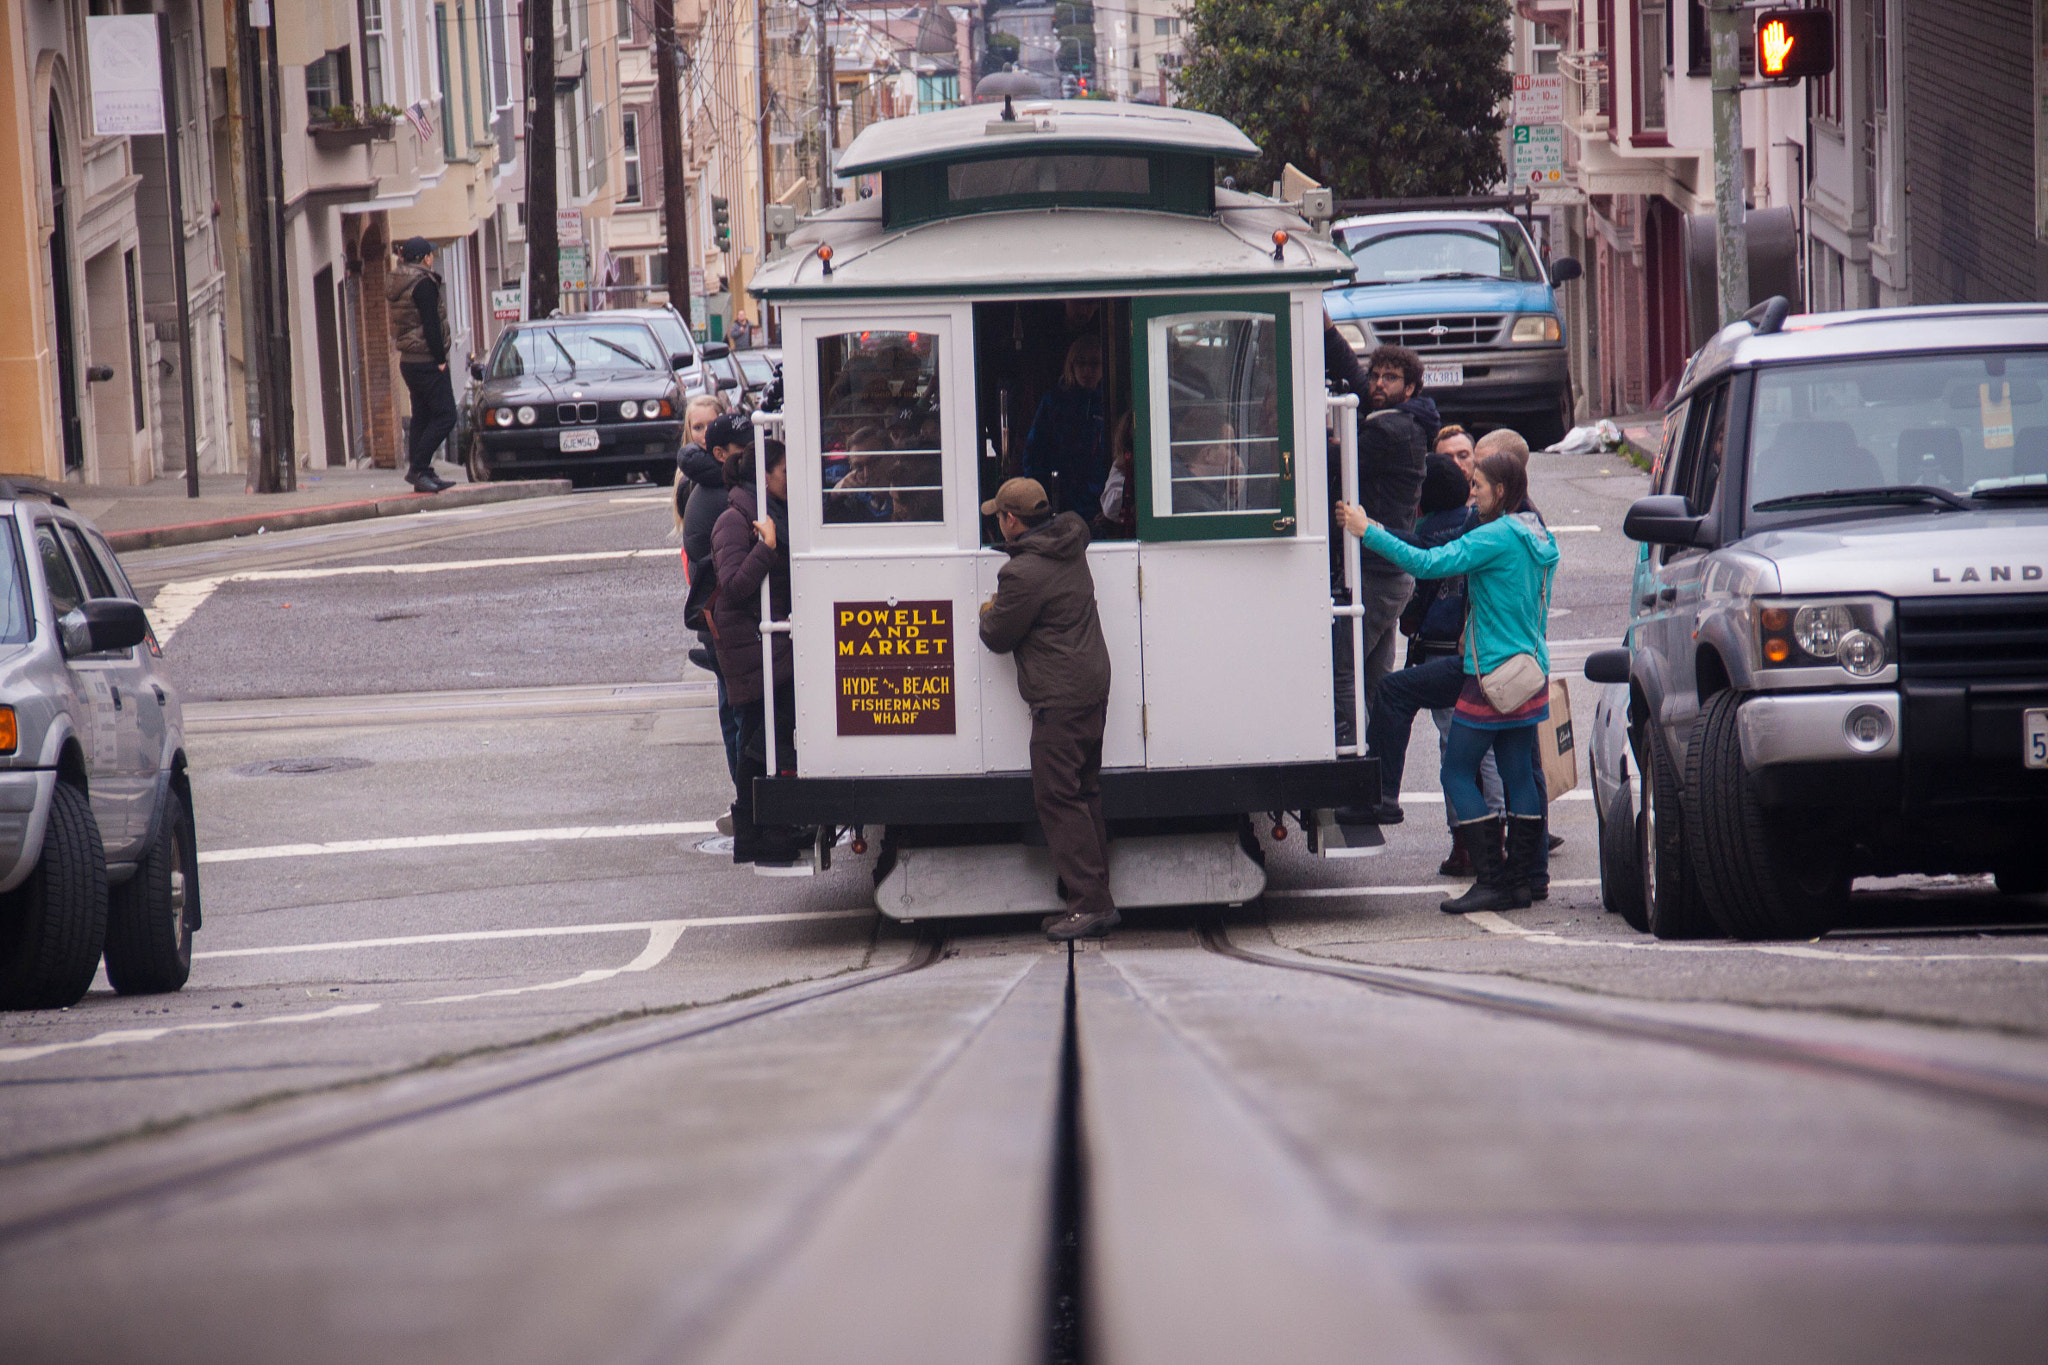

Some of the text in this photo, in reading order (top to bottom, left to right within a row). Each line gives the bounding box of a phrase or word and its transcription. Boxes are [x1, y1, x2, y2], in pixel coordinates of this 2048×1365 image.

[1516, 76, 1560, 89] NO PARKING
[1517, 128, 1528, 142] 2
[1933, 566, 2044, 582] LAND
[840, 609, 946, 626] POWELL
[868, 626, 920, 639] AND
[839, 639, 948, 656] MARKET
[842, 676, 950, 695] HYDE AND BEACH
[851, 698, 941, 711] FISHERMANS
[873, 712, 919, 724] WHARF
[2032, 733, 2047, 759] 5
